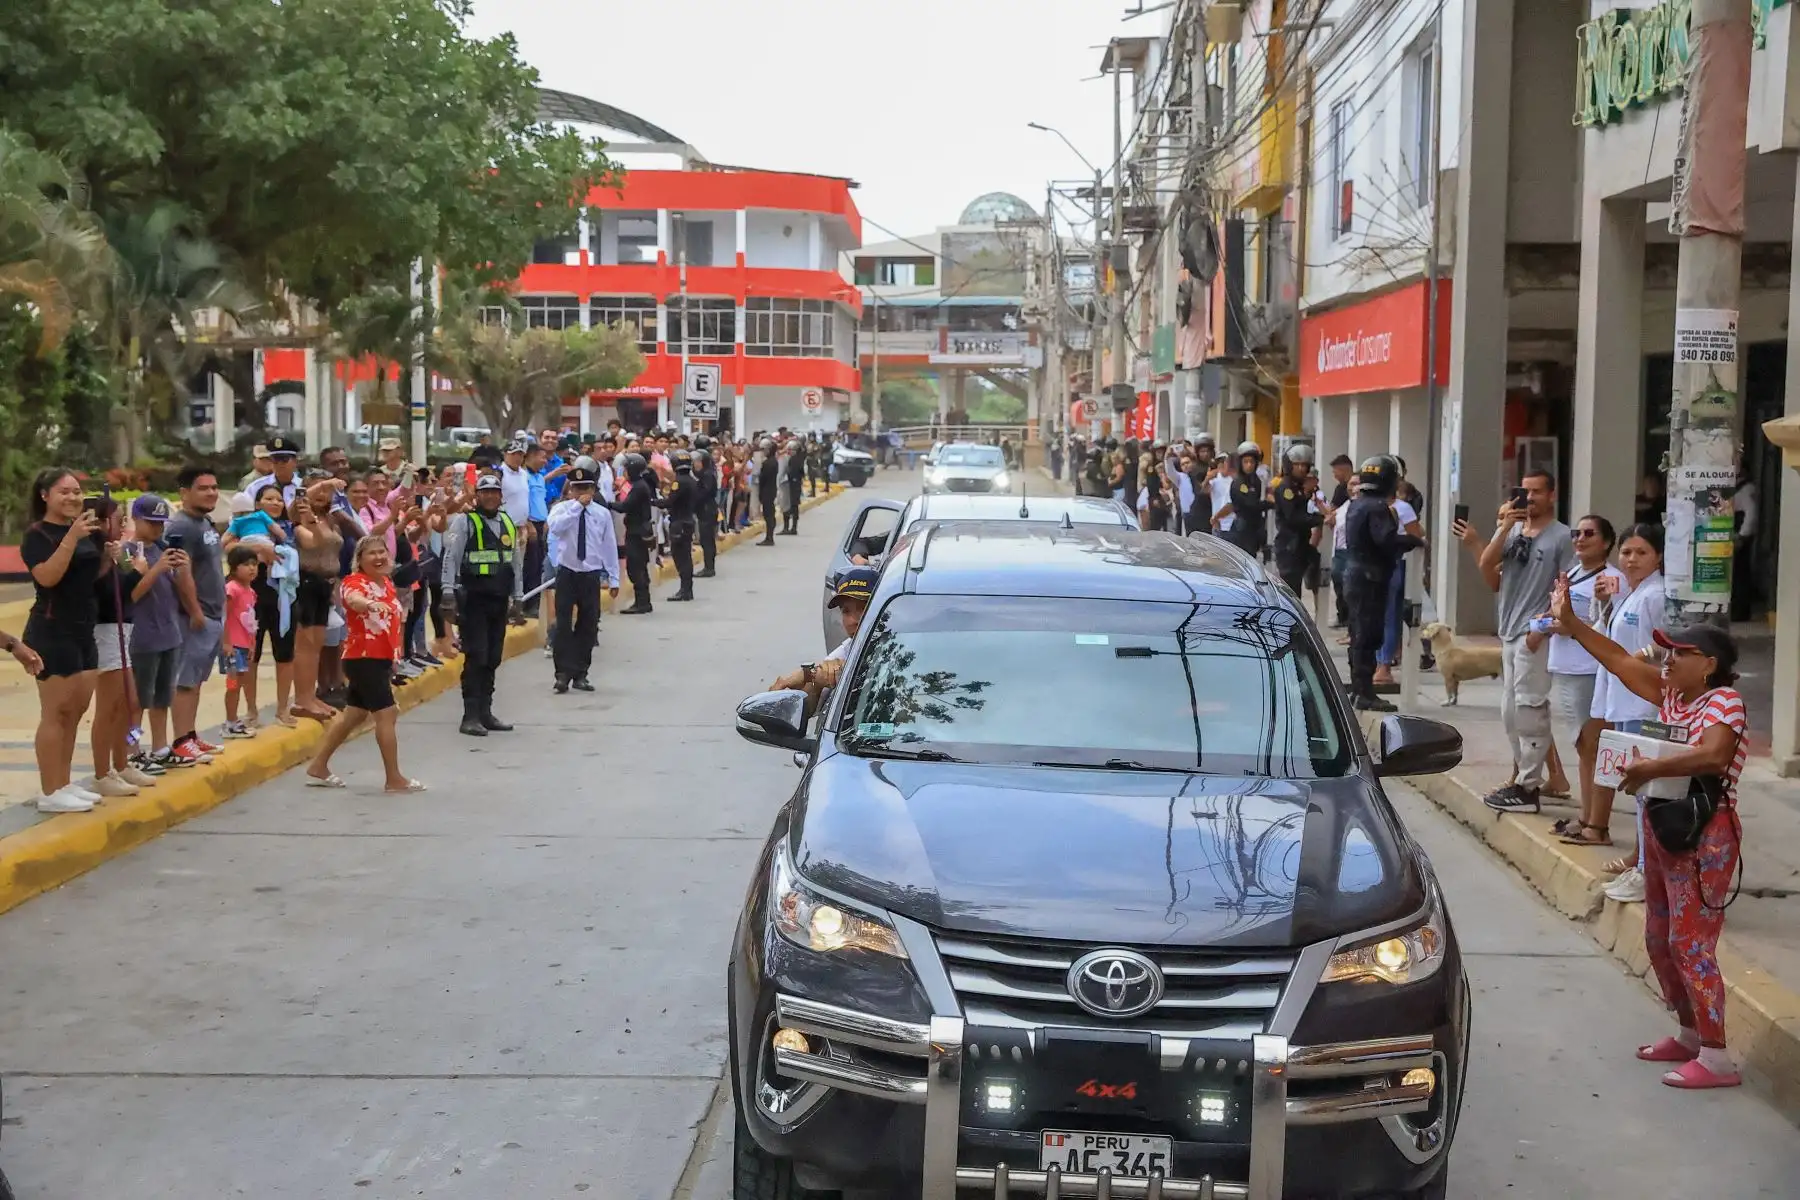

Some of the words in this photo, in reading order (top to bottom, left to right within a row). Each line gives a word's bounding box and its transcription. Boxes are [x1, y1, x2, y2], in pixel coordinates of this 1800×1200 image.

[1325, 333, 1357, 372] Santander
[1357, 330, 1392, 366] Consumer
[1681, 349, 1697, 361] 940
[1700, 349, 1717, 361] 758
[696, 374, 708, 391] E
[1685, 471, 1697, 479] SE
[1699, 471, 1736, 479] ALQUILA
[1076, 1079, 1137, 1099] 4x4
[1084, 1135, 1130, 1150] PERU
